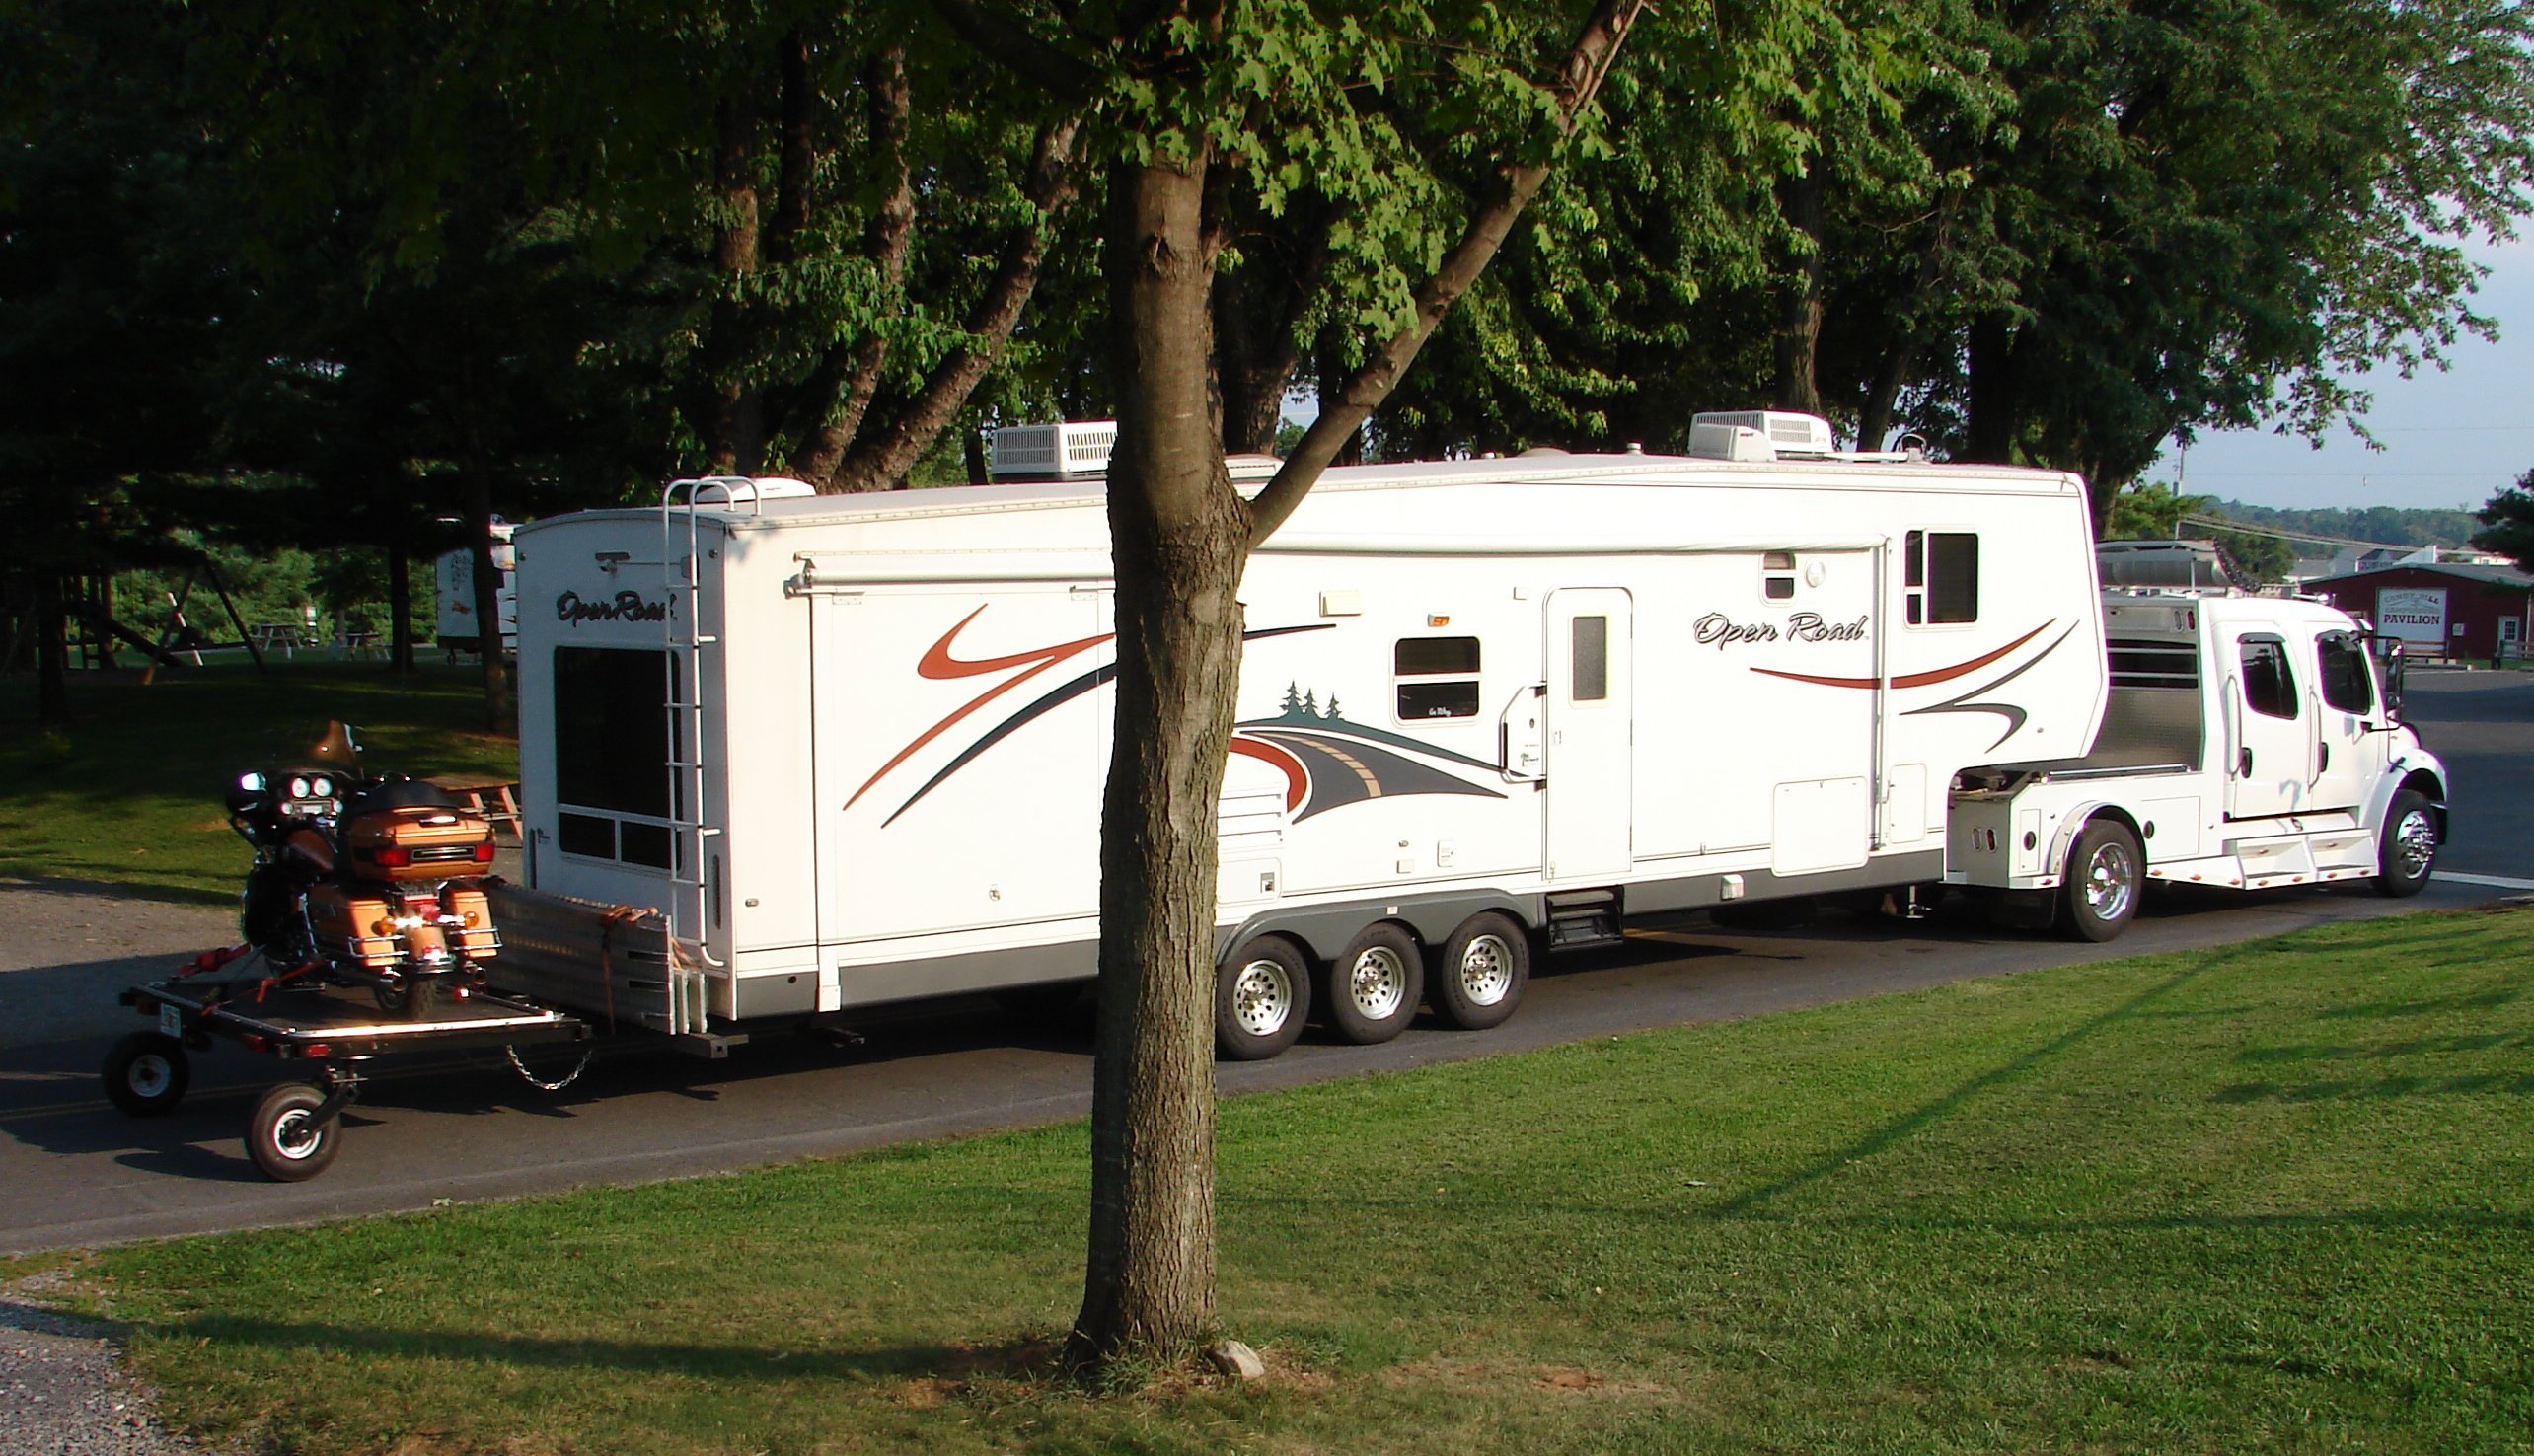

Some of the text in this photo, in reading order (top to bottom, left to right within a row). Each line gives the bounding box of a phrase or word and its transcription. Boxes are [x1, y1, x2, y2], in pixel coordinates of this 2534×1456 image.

[556, 590, 613, 628] Open
[2384, 614, 2440, 625] PAVILION
[1693, 612, 1869, 651] Open Road
